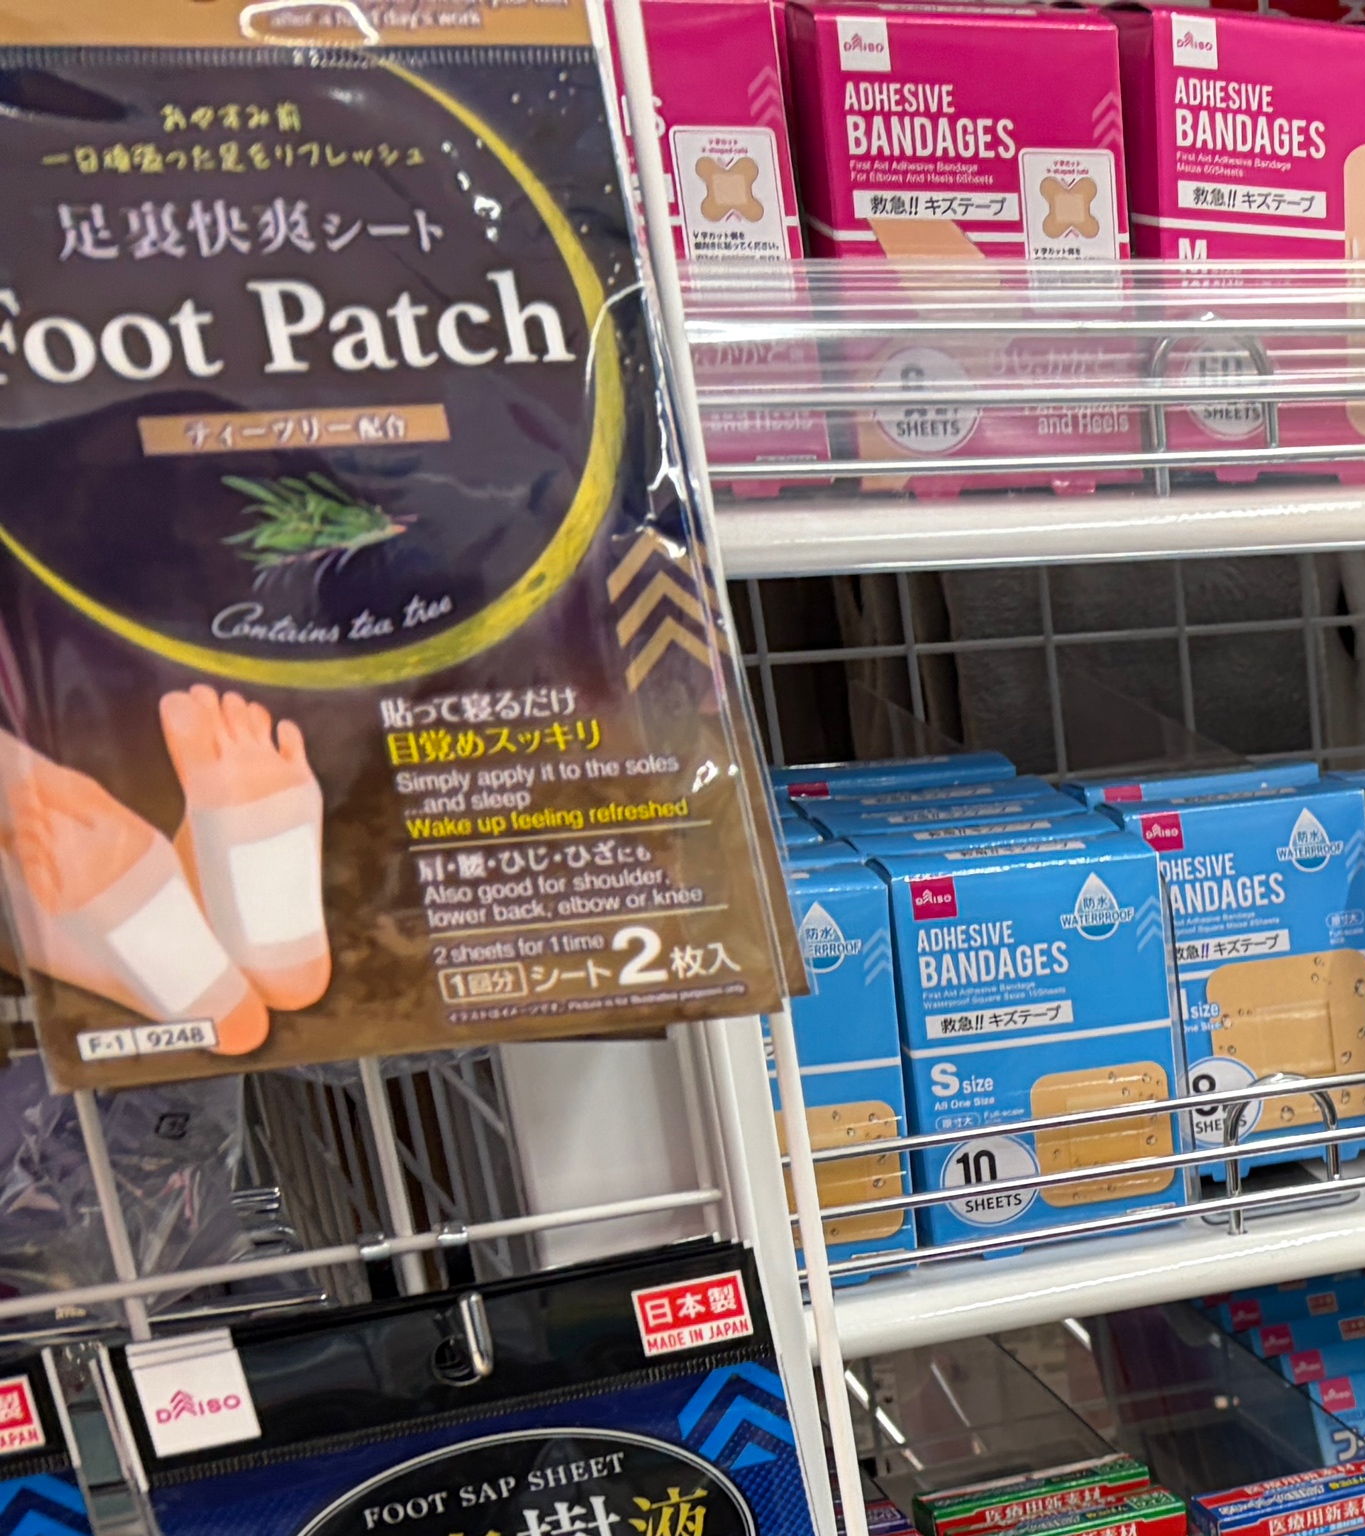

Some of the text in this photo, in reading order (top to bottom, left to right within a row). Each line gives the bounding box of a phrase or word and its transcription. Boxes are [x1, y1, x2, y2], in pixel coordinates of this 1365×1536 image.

[844, 81, 956, 113] ADHESIVE
[1174, 76, 1274, 114] ADHESIVE
[845, 114, 1017, 159] BANDAGES
[1175, 106, 1327, 160] BANDAGES
[924, 196, 1007, 216] キズテープ
[56, 196, 444, 263] 足裏快爽シート
[247, 269, 575, 374] Patch
[210, 593, 455, 644] Contains tea tree
[381, 686, 577, 728] 貼って寝るだけ
[387, 717, 602, 766] 目覚めスッキリ
[395, 754, 680, 795] Simply apply it to the soles
[406, 797, 689, 841] Wake up feeling refreshed
[1276, 841, 1344, 862] WATERPROOF
[424, 884, 472, 905] Also
[478, 880, 533, 907] good
[536, 875, 566, 894] for
[427, 886, 704, 929] lower back, elbow or knee
[917, 919, 1015, 953] ADHESIVE
[1059, 906, 1134, 930] WATERPROOF
[918, 941, 1070, 989] BANDAGES
[1213, 934, 1279, 957] キズテープ
[940, 1005, 1062, 1034] 救急!! キズテープ
[930, 1062, 994, 1098] S size
[964, 1193, 1023, 1214] SHEETS
[644, 1285, 738, 1326] 日本製
[646, 1318, 750, 1353] MADE IN JAPAN
[156, 1389, 242, 1426] DAISO
[363, 1451, 625, 1529] FOOT SAP SHEET
